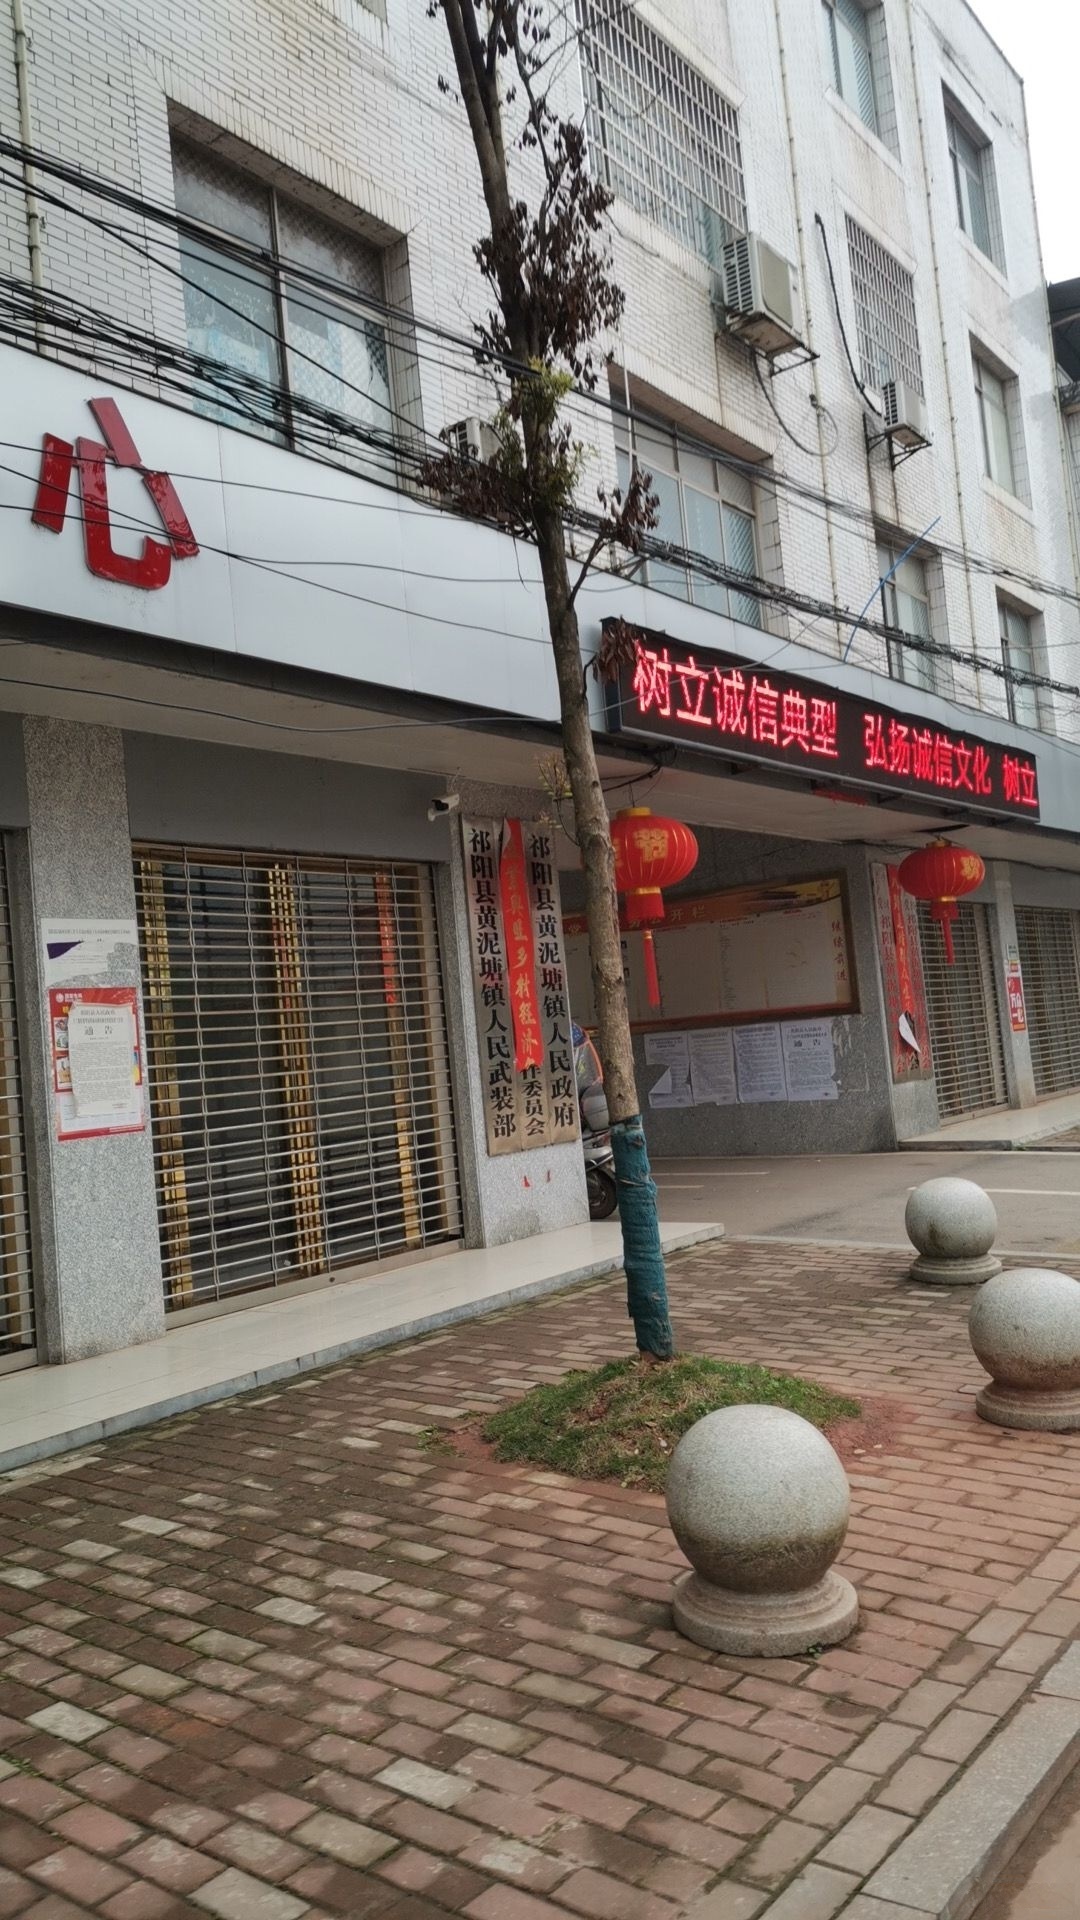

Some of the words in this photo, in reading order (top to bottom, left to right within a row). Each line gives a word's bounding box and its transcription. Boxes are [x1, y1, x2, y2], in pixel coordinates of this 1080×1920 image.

[31, 397, 200, 590] 心
[633, 639, 839, 758] 树立诚信典型
[863, 713, 992, 795] 弘扬诚信文化
[1002, 752, 1039, 807] 树立
[468, 827, 517, 1139] 祁阳县黄泥塘镇人民武装部
[527, 833, 576, 1129] 祁阳县黄泥塘镇人民政府
